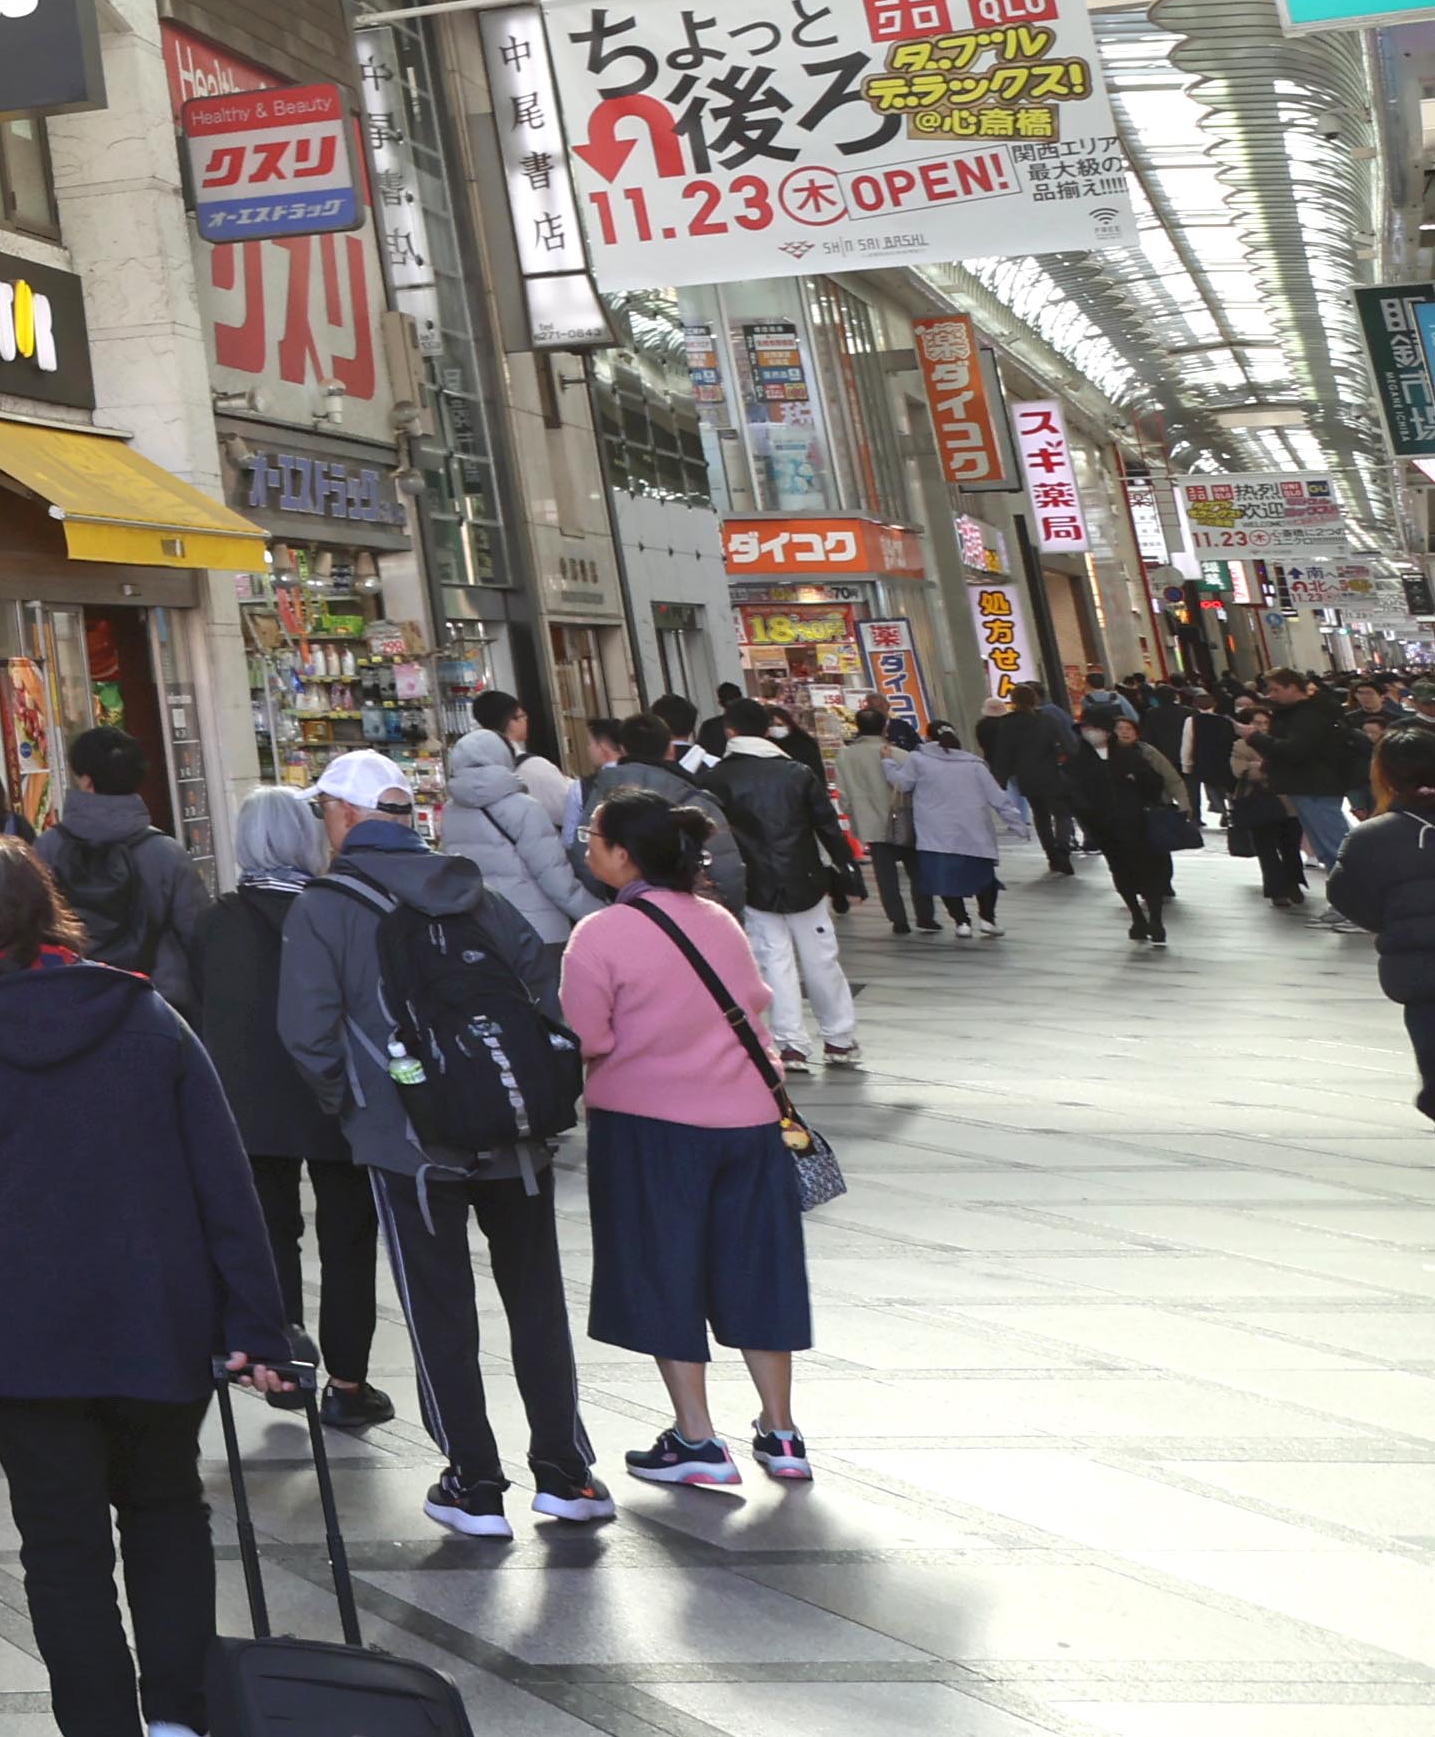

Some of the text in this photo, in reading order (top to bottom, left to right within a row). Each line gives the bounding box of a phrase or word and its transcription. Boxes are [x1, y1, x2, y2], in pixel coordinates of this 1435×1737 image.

[877, 6, 940, 36] クロ
[892, 27, 1048, 69] ダブル
[866, 65, 1086, 110] デラックス!
[192, 95, 332, 126] Healthy & Beauty
[668, 51, 903, 174] 後ろ
[914, 109, 1054, 138] @心斎橋
[202, 135, 338, 188] クスリ
[499, 35, 565, 253] 中尾書店
[1013, 136, 1119, 165] 関西エリア
[1028, 156, 1123, 181] 最大級の
[207, 198, 346, 228] オーエスドラッグ
[588, 178, 775, 246] 11.23
[852, 154, 1010, 213] OPEN!
[1019, 409, 1084, 543] スギ薬局
[728, 530, 858, 565] ダイコク
[1192, 531, 1248, 548] 11.23
